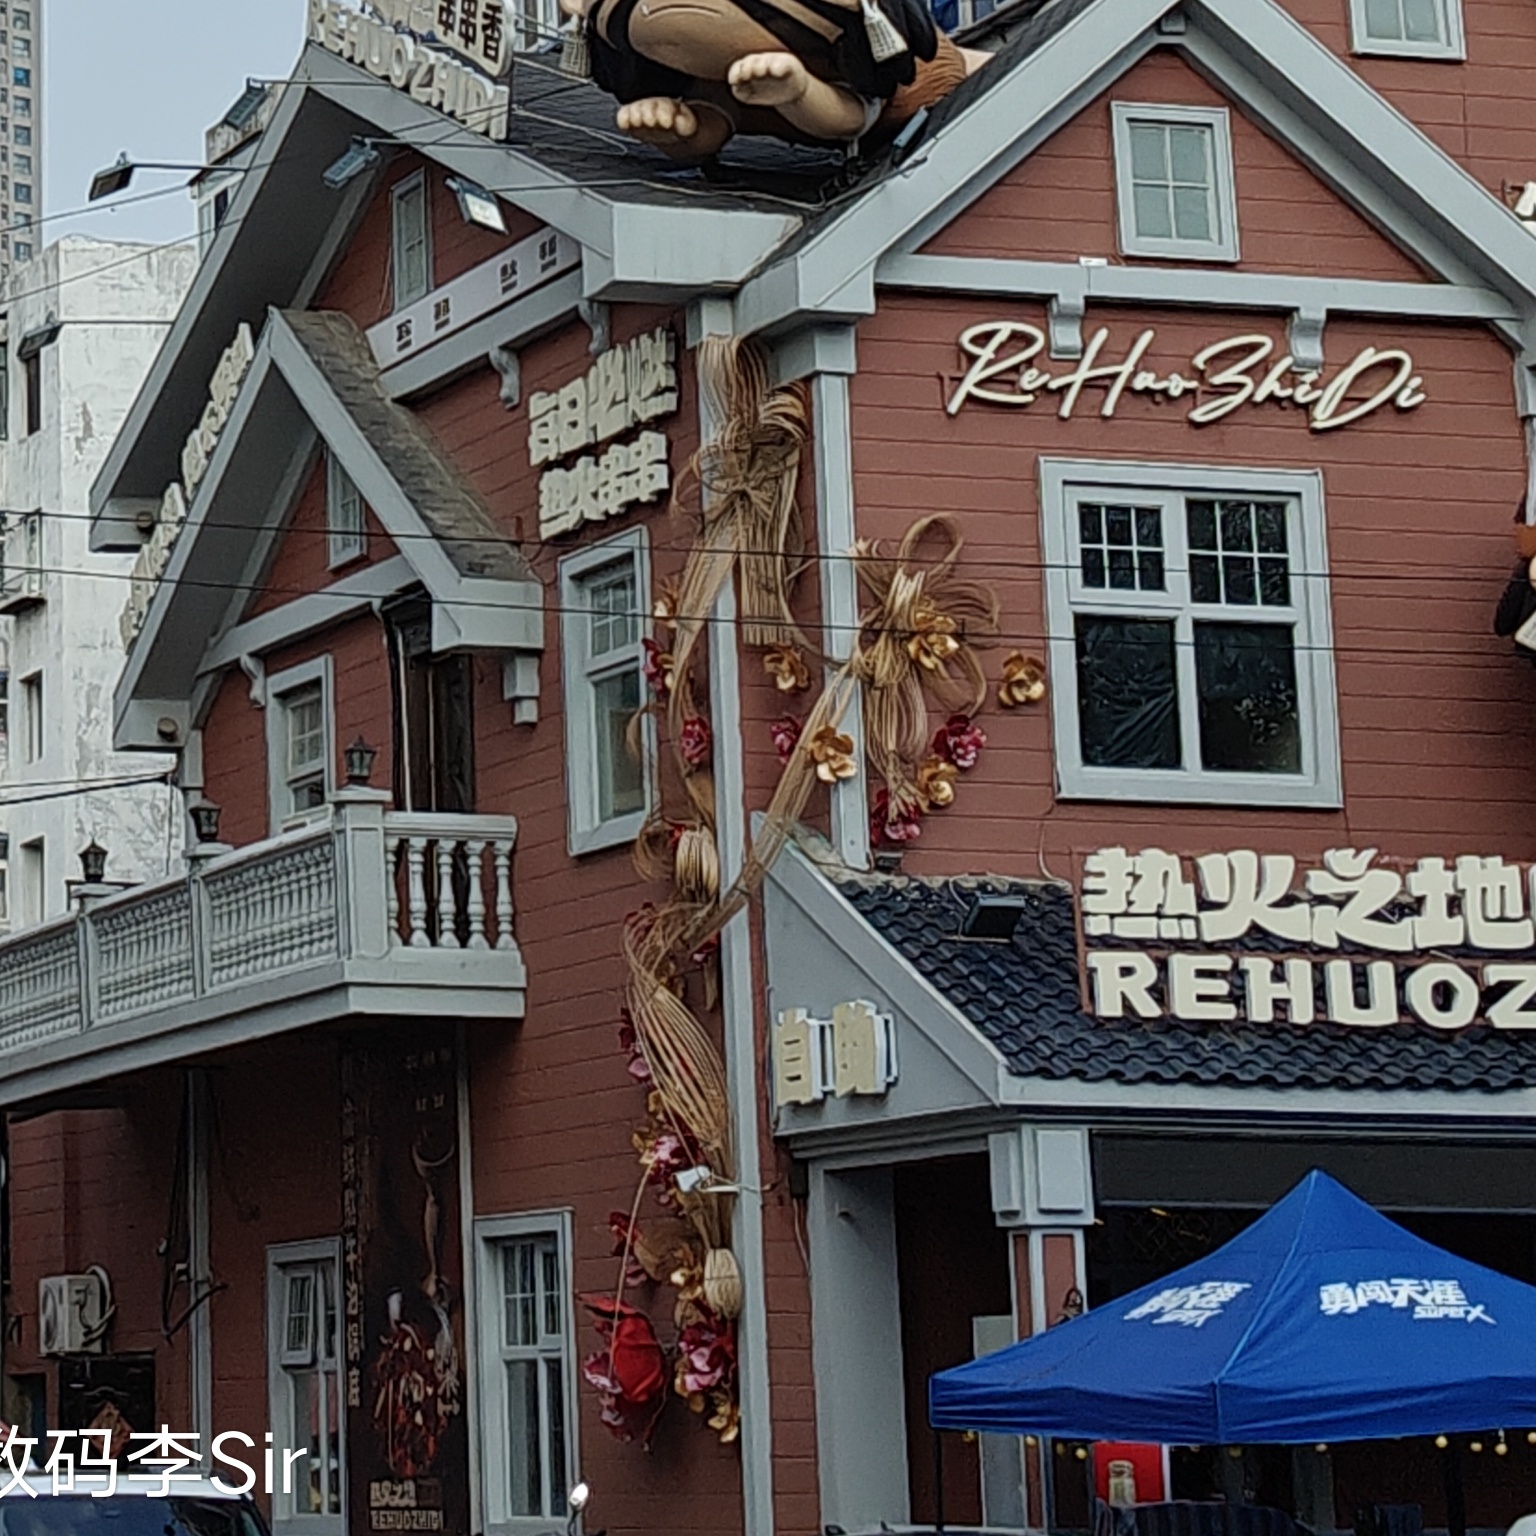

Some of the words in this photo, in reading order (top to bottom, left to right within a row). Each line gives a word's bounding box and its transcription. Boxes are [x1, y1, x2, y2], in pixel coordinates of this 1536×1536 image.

[1081, 846, 1535, 952] 热火之地
[1086, 950, 1536, 1031] REHUOZ
[1320, 1278, 1469, 1316] 勇闯天涯
